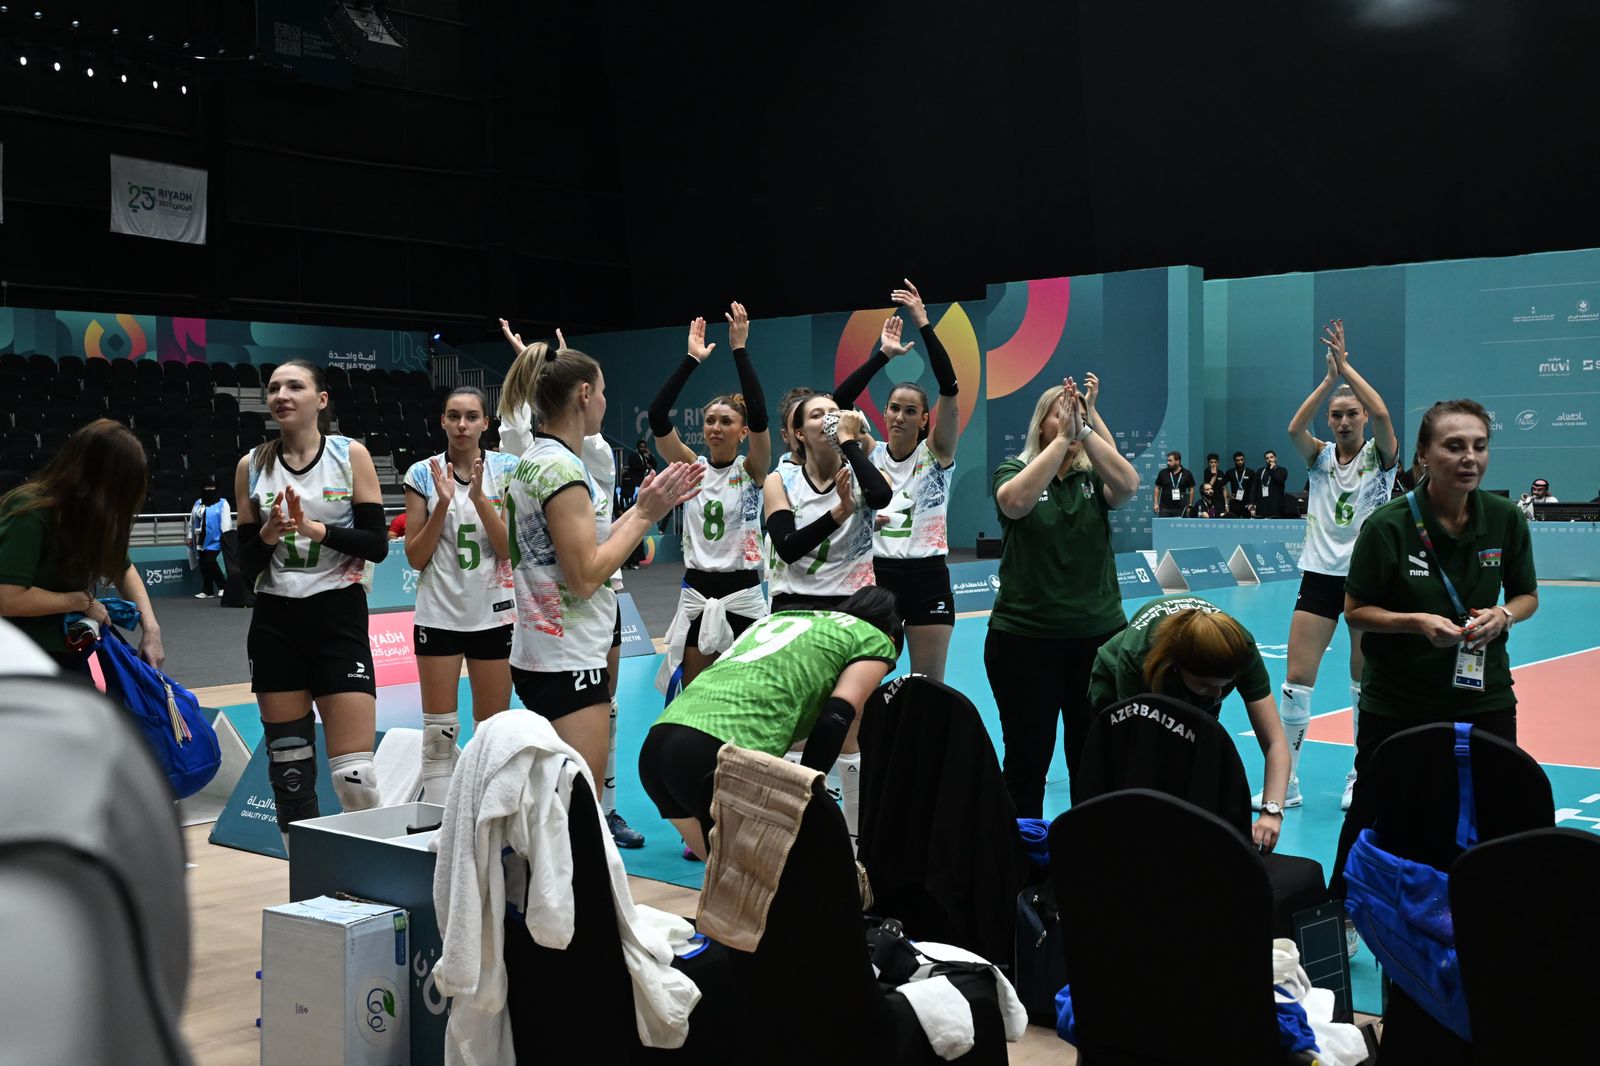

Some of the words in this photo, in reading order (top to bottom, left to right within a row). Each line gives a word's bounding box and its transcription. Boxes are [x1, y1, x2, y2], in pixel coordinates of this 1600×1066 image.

[158, 189, 193, 202] RIYADH
[703, 499, 725, 542] 8
[1334, 491, 1354, 527] 6
[457, 523, 481, 571] 5
[1409, 569, 1430, 577] nine
[369, 630, 405, 646] YADH
[418, 626, 429, 644] 5
[572, 669, 602, 692] 20
[1110, 702, 1196, 743] AZERBAIJAN
